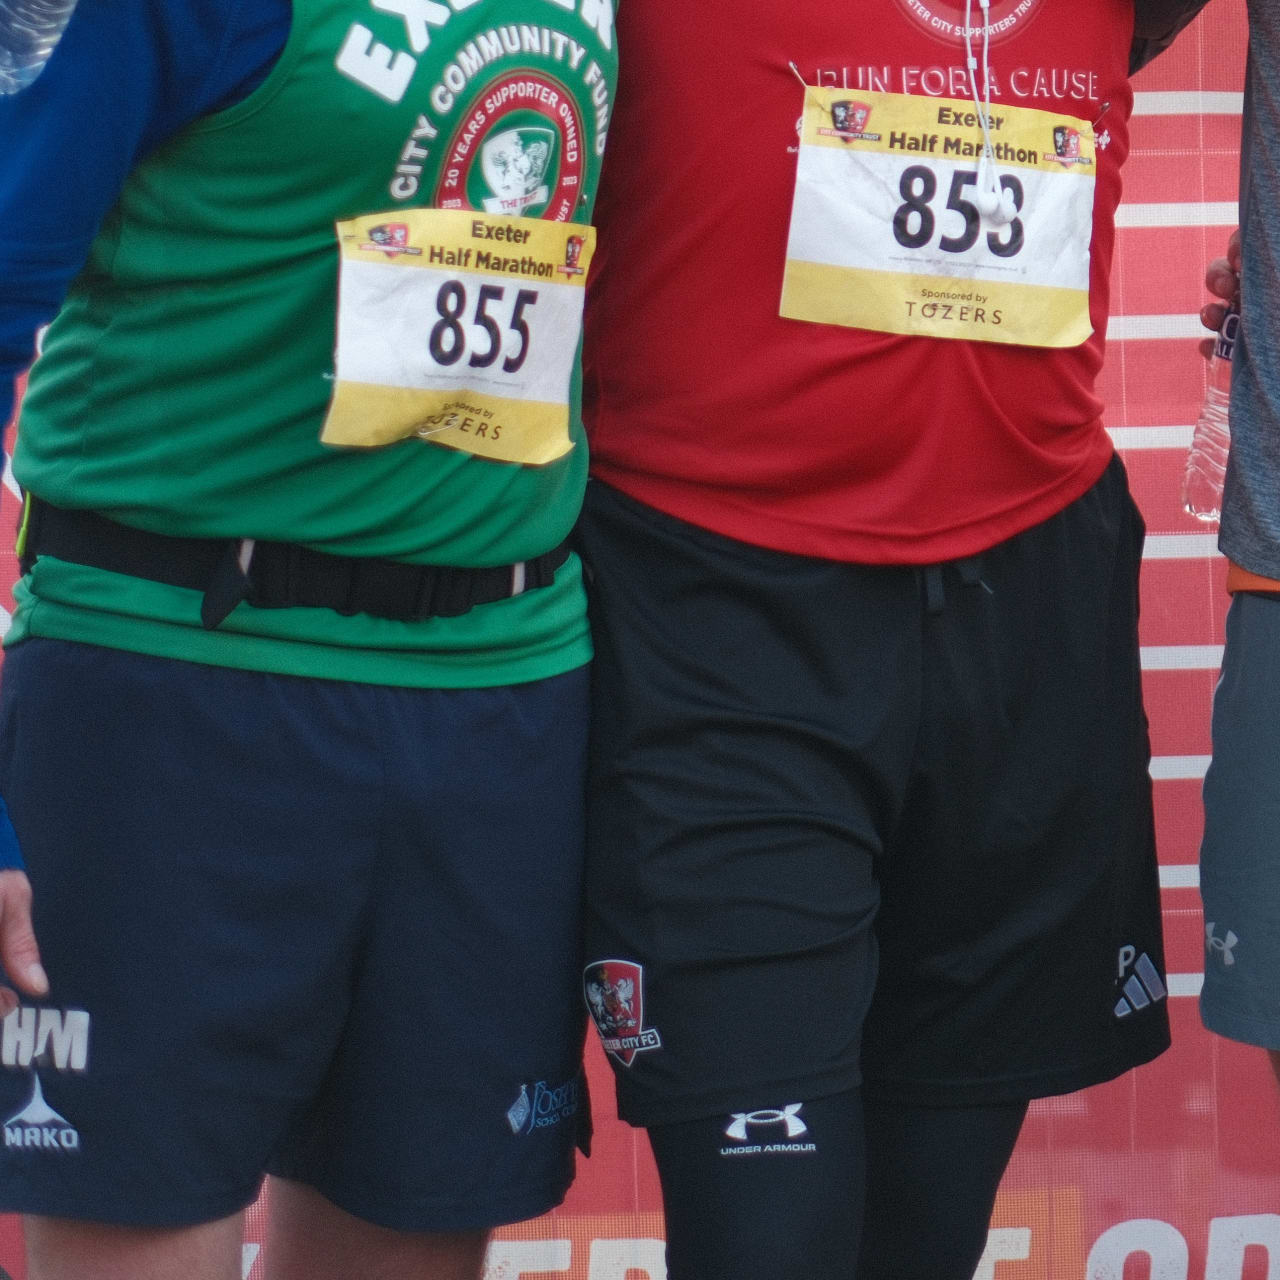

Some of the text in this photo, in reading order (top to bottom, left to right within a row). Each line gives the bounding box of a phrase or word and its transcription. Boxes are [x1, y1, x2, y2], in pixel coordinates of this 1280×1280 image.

[931, 16, 953, 33] CITY
[954, 14, 1016, 37] SUPPORTERS
[902, 67, 971, 95] FOR
[1010, 70, 1099, 100] CAUSE
[390, 24, 609, 200] CITY COMMUNITY FUND
[445, 82, 578, 187] 20 YEARS SUPPORTER OWNED
[889, 131, 937, 153] Half
[555, 199, 571, 221] UST
[472, 220, 530, 243] Exeter
[429, 245, 473, 268] Half
[475, 249, 553, 277] Marathon
[921, 288, 988, 303] Sponsored by
[905, 301, 1002, 324] TOZERS
[429, 280, 538, 373] 855
[622, 1034, 655, 1048] CITY FC
[4, 1127, 79, 1148] MAKO
[720, 1142, 816, 1155] UNDER ARMOUR
